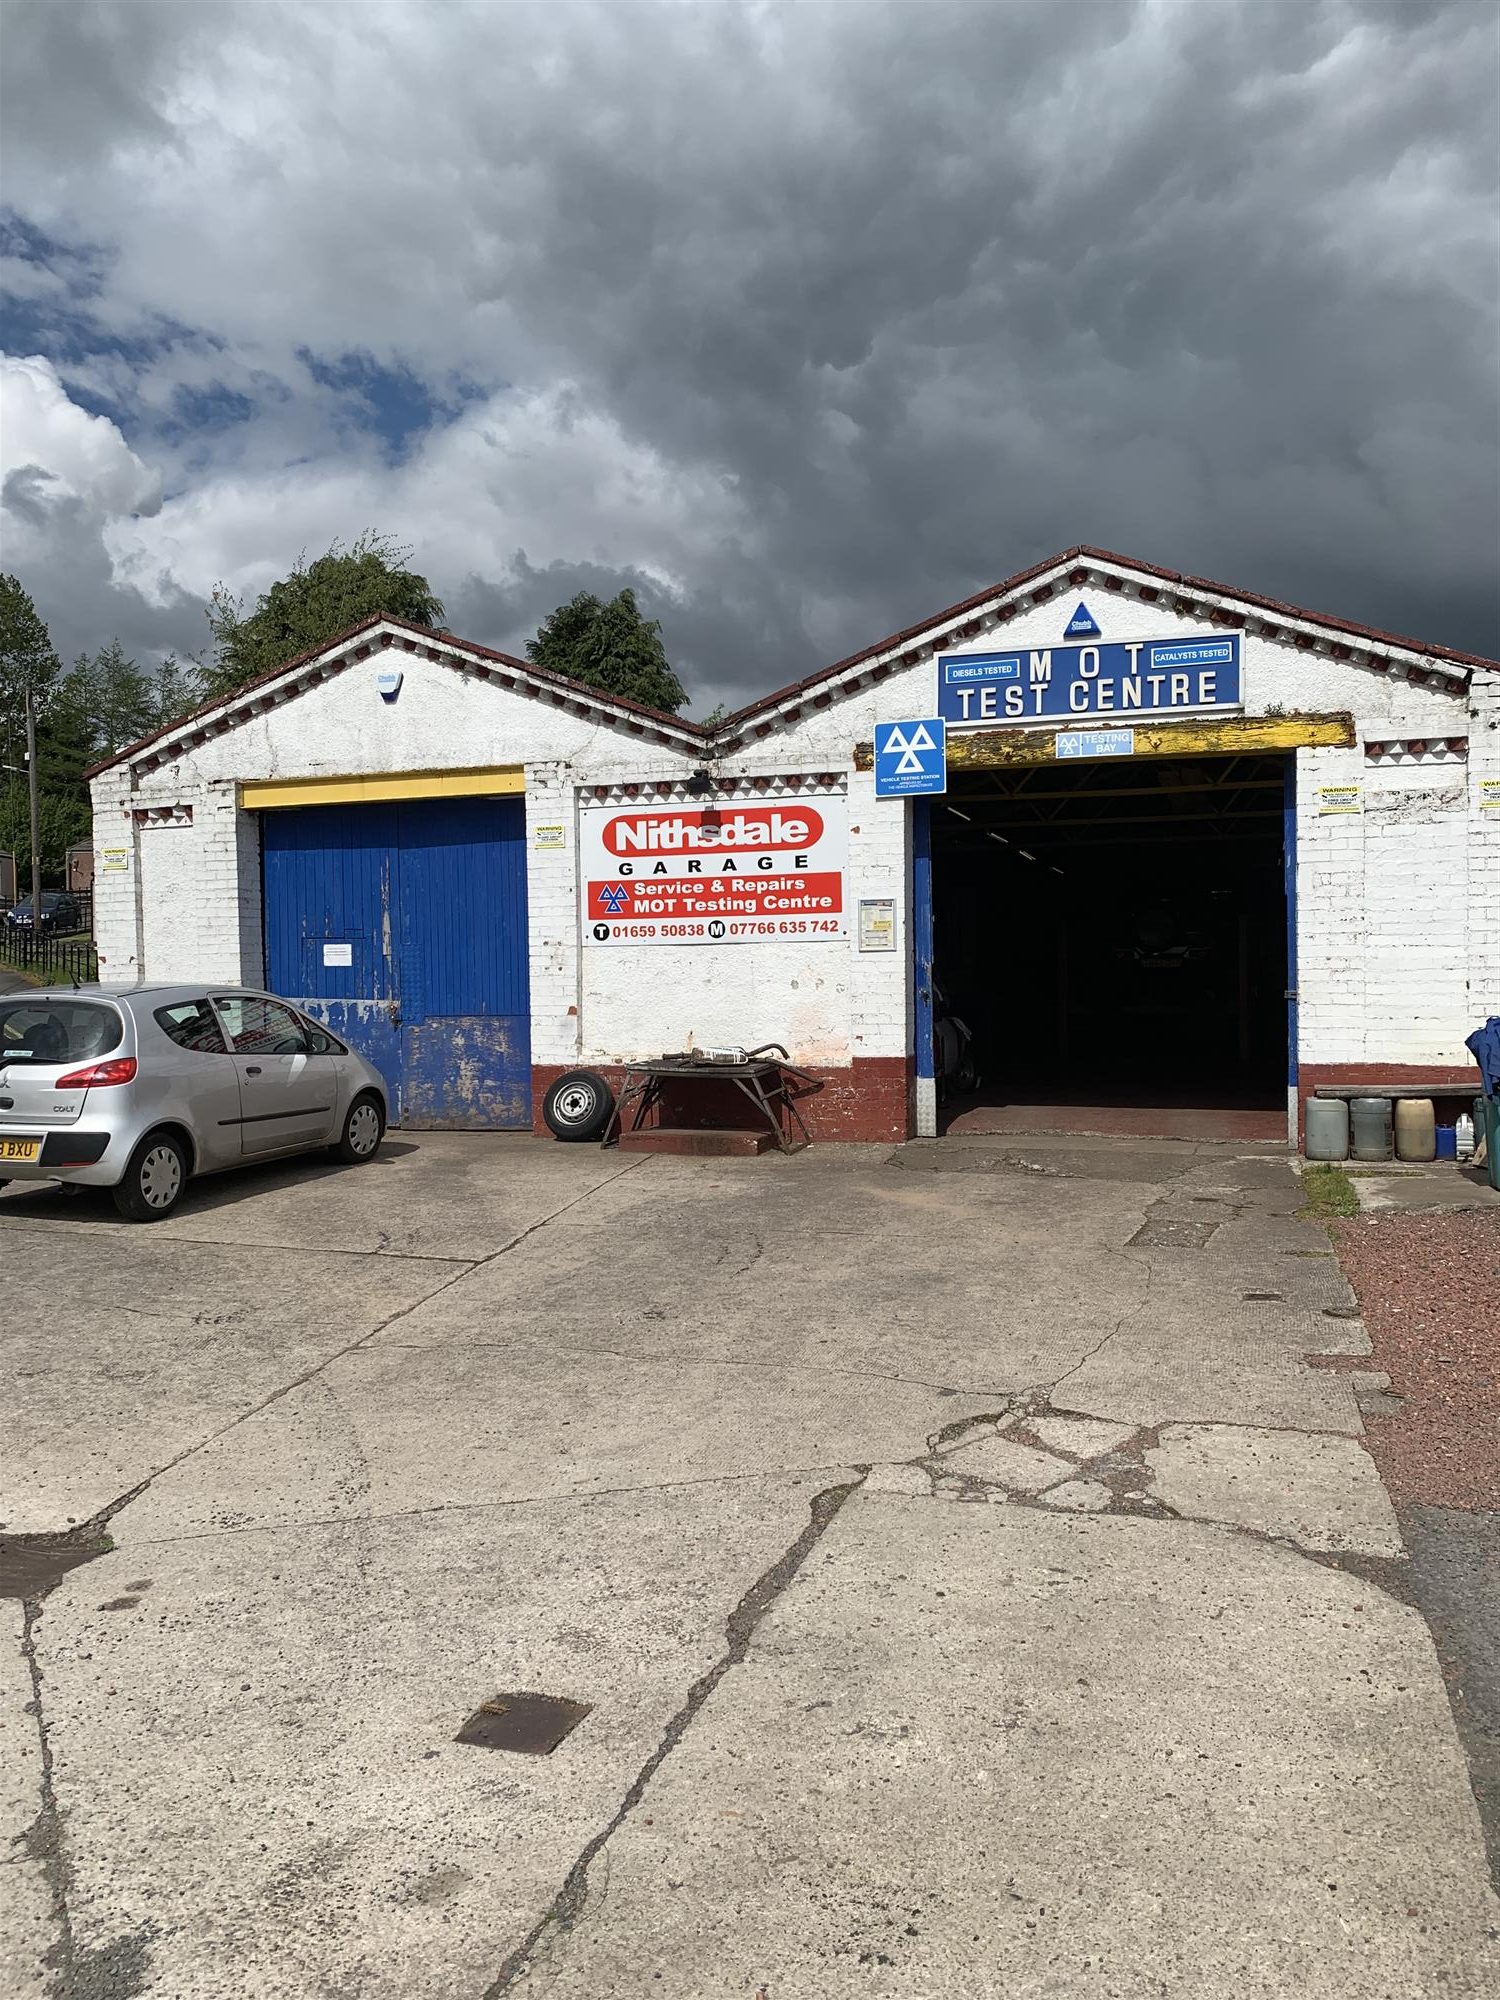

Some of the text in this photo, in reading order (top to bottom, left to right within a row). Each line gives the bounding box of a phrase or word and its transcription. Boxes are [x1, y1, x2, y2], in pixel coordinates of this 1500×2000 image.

[1154, 648, 1229, 662] CATALYSTS TESTED
[952, 665, 1013, 678] DIESELS TESTED
[957, 671, 1217, 719] TEST CENTRE
[1084, 732, 1129, 744] TESTING
[1096, 743, 1117, 753] BAY
[615, 813, 809, 851] Nithsdale
[618, 855, 808, 876] GARAGE
[634, 877, 805, 896] Service & Repairs
[634, 895, 833, 913] MOT Testing Centre
[612, 925, 656, 938] 01659
[660, 923, 705, 936] 50838
[729, 921, 776, 935] 07766
[779, 920, 807, 933] 635
[811, 919, 839, 932] 742
[7, 1142, 33, 1156] BXU
